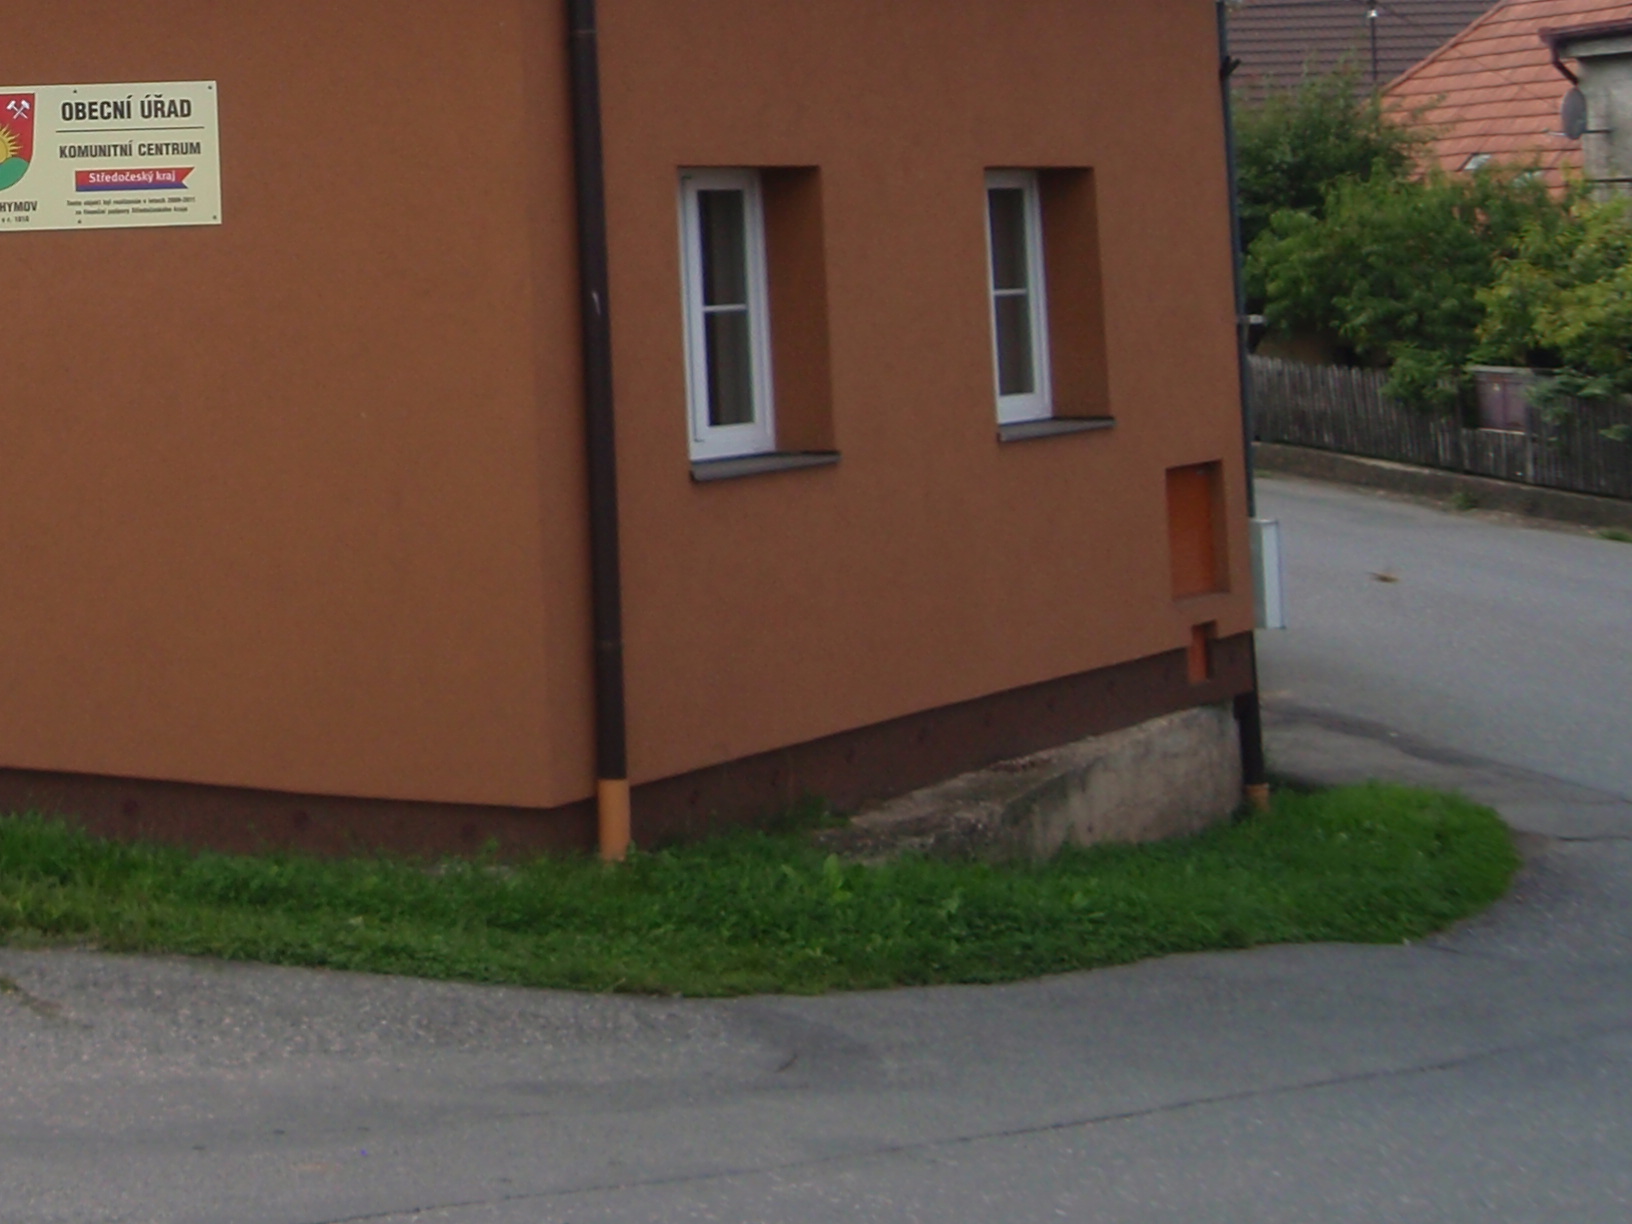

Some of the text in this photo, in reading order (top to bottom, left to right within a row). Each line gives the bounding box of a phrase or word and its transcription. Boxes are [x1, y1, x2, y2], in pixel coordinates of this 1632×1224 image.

[61, 94, 192, 121] OBECNÍ ÚŘAD
[59, 140, 201, 158] KOMUNITNÍ CENTRUM
[88, 171, 176, 183] Středočeský kraj
